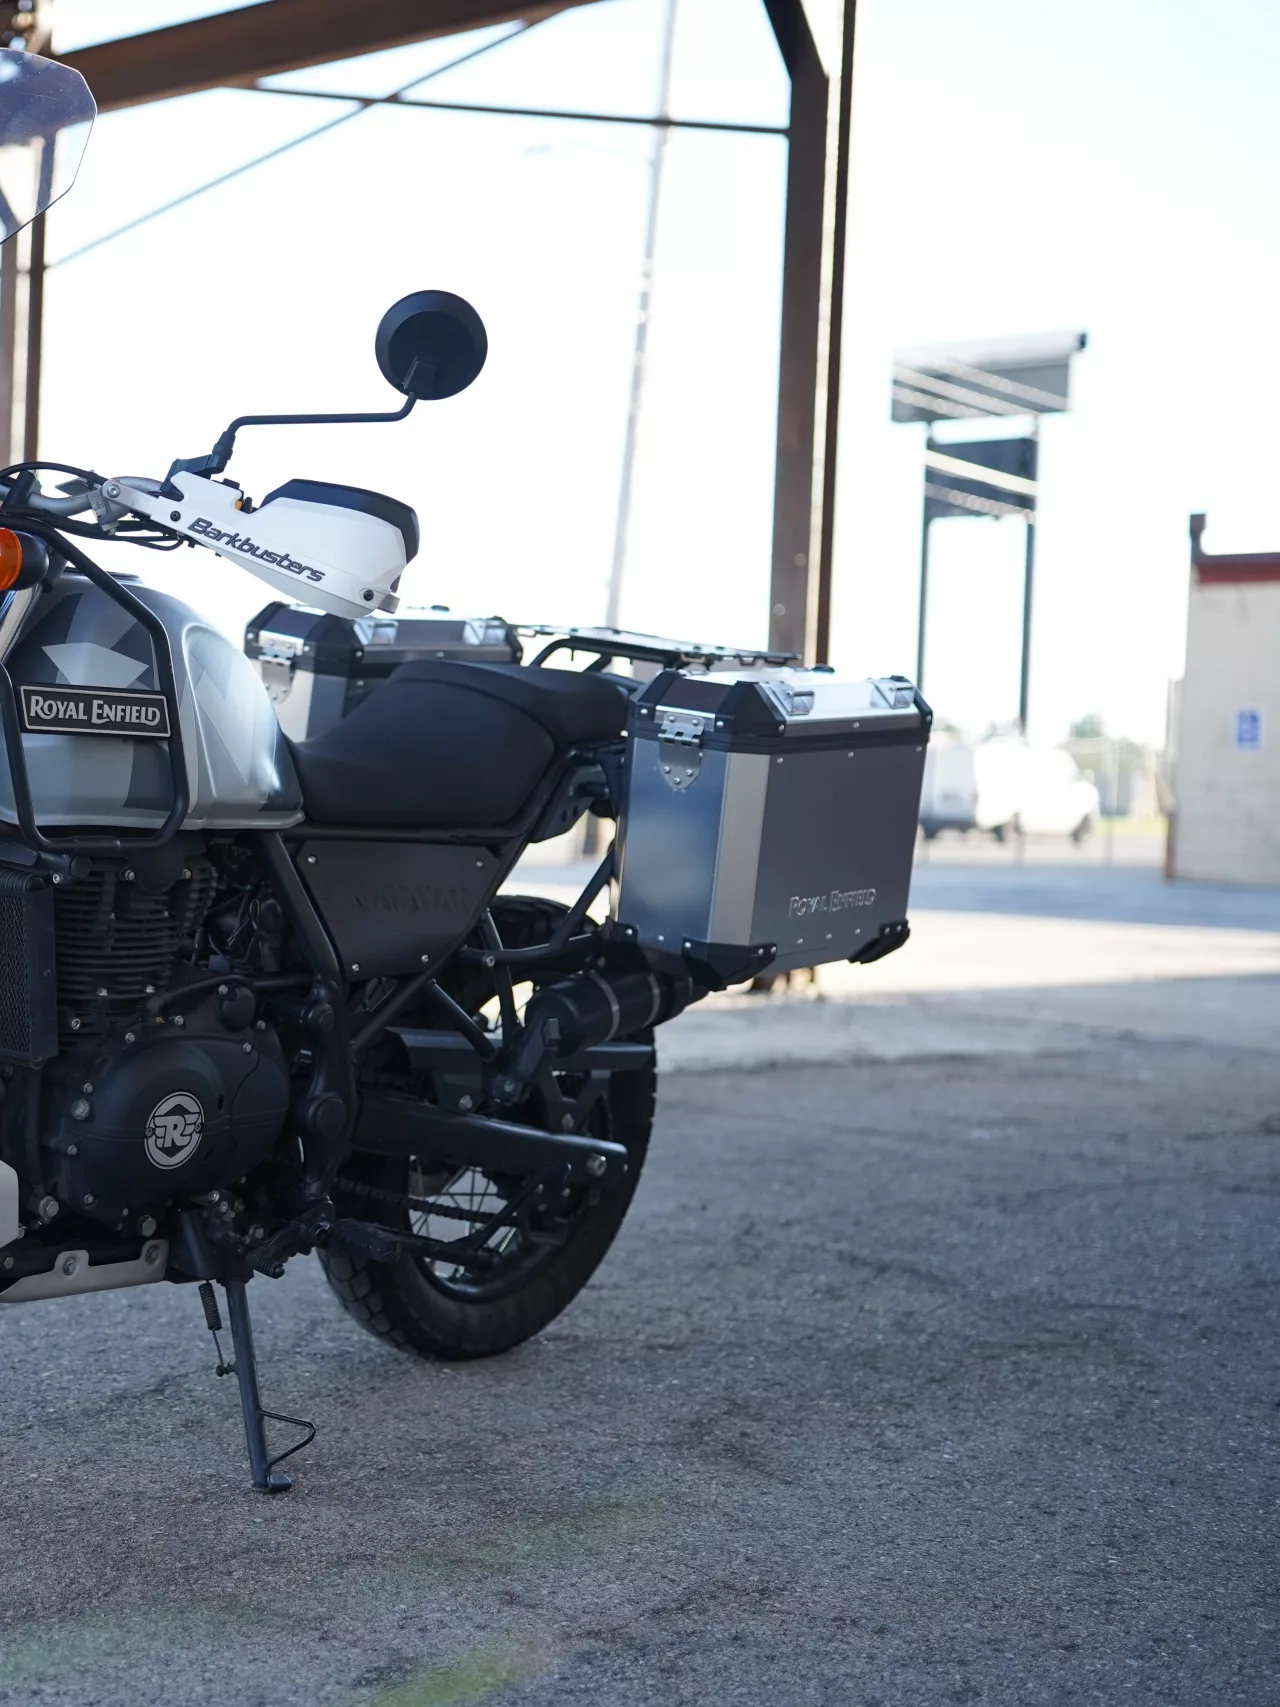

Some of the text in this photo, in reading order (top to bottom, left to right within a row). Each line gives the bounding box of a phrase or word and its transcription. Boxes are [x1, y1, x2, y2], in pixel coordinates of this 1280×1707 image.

[187, 517, 326, 582] Barkbusters
[29, 695, 161, 727] ROYAL ENFIELD
[788, 887, 877, 918] ROYAL ENFIELD
